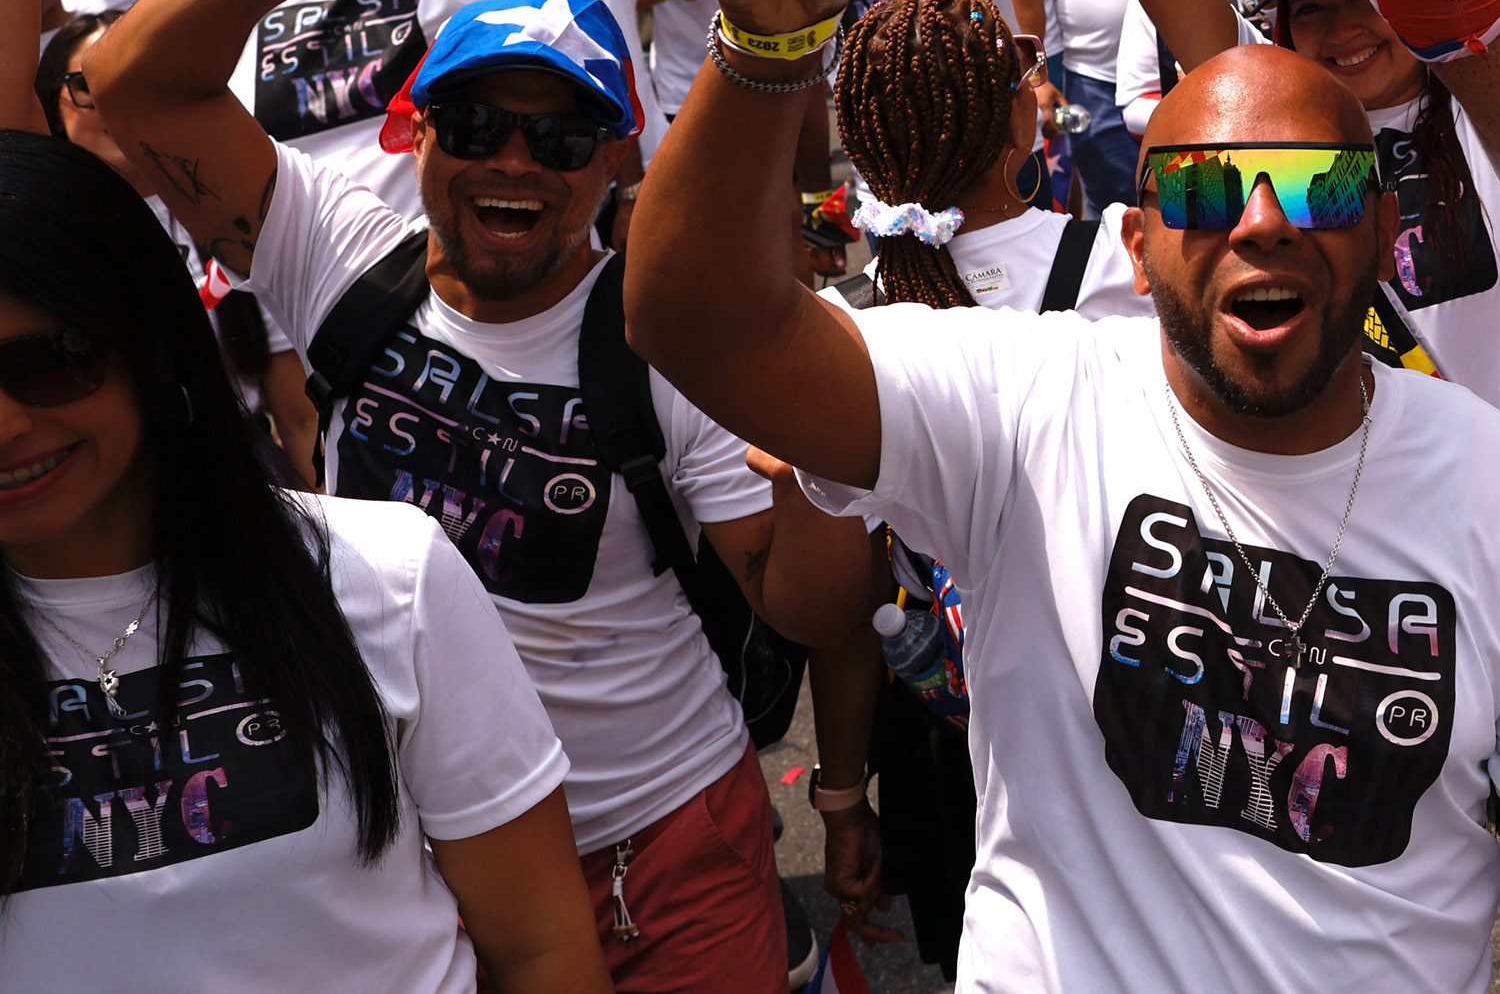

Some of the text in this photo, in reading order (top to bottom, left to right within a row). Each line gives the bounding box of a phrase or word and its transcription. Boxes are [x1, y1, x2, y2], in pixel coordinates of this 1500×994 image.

[291, 58, 385, 124] NYC
[747, 37, 781, 52] 2023
[349, 397, 596, 515] ESTILO
[553, 485, 587, 501] PR
[1131, 511, 1439, 657] SALSA
[1109, 607, 1440, 747] ESTILO
[1388, 705, 1428, 729] PR
[57, 766, 229, 874] NYC
[1166, 698, 1349, 844] NYC
